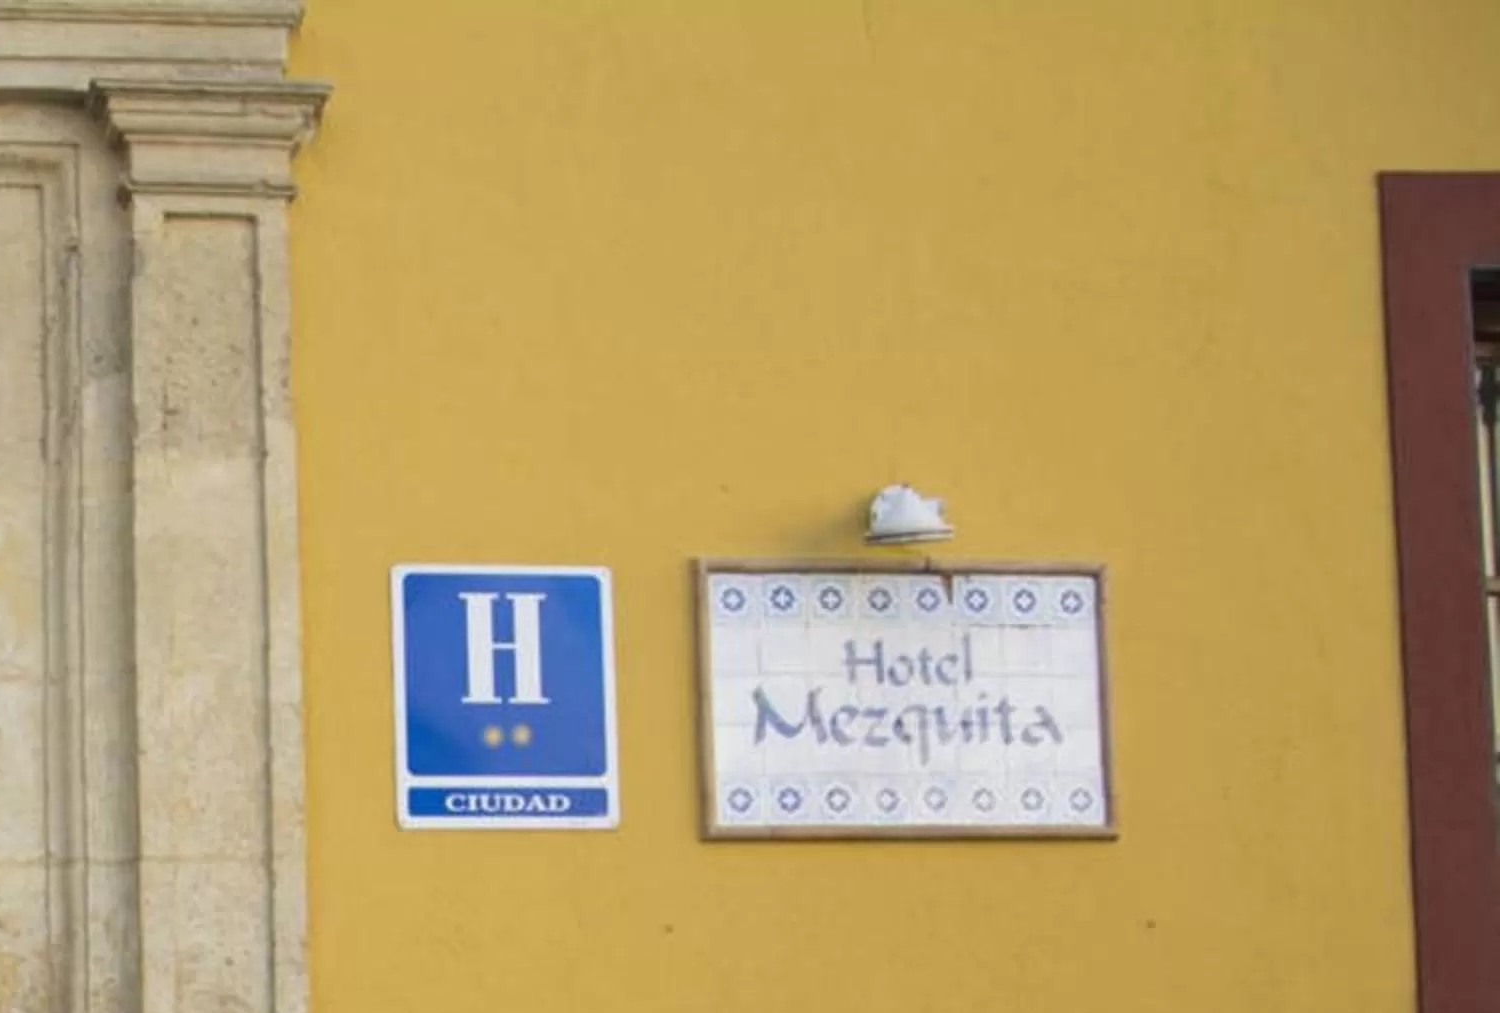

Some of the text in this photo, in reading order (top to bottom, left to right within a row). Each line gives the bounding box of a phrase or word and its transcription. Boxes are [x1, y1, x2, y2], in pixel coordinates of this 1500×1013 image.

[457, 591, 552, 705] H
[843, 632, 973, 687] Hotel
[751, 685, 1065, 767] Mezquita
[445, 793, 571, 813] CIUDAD
